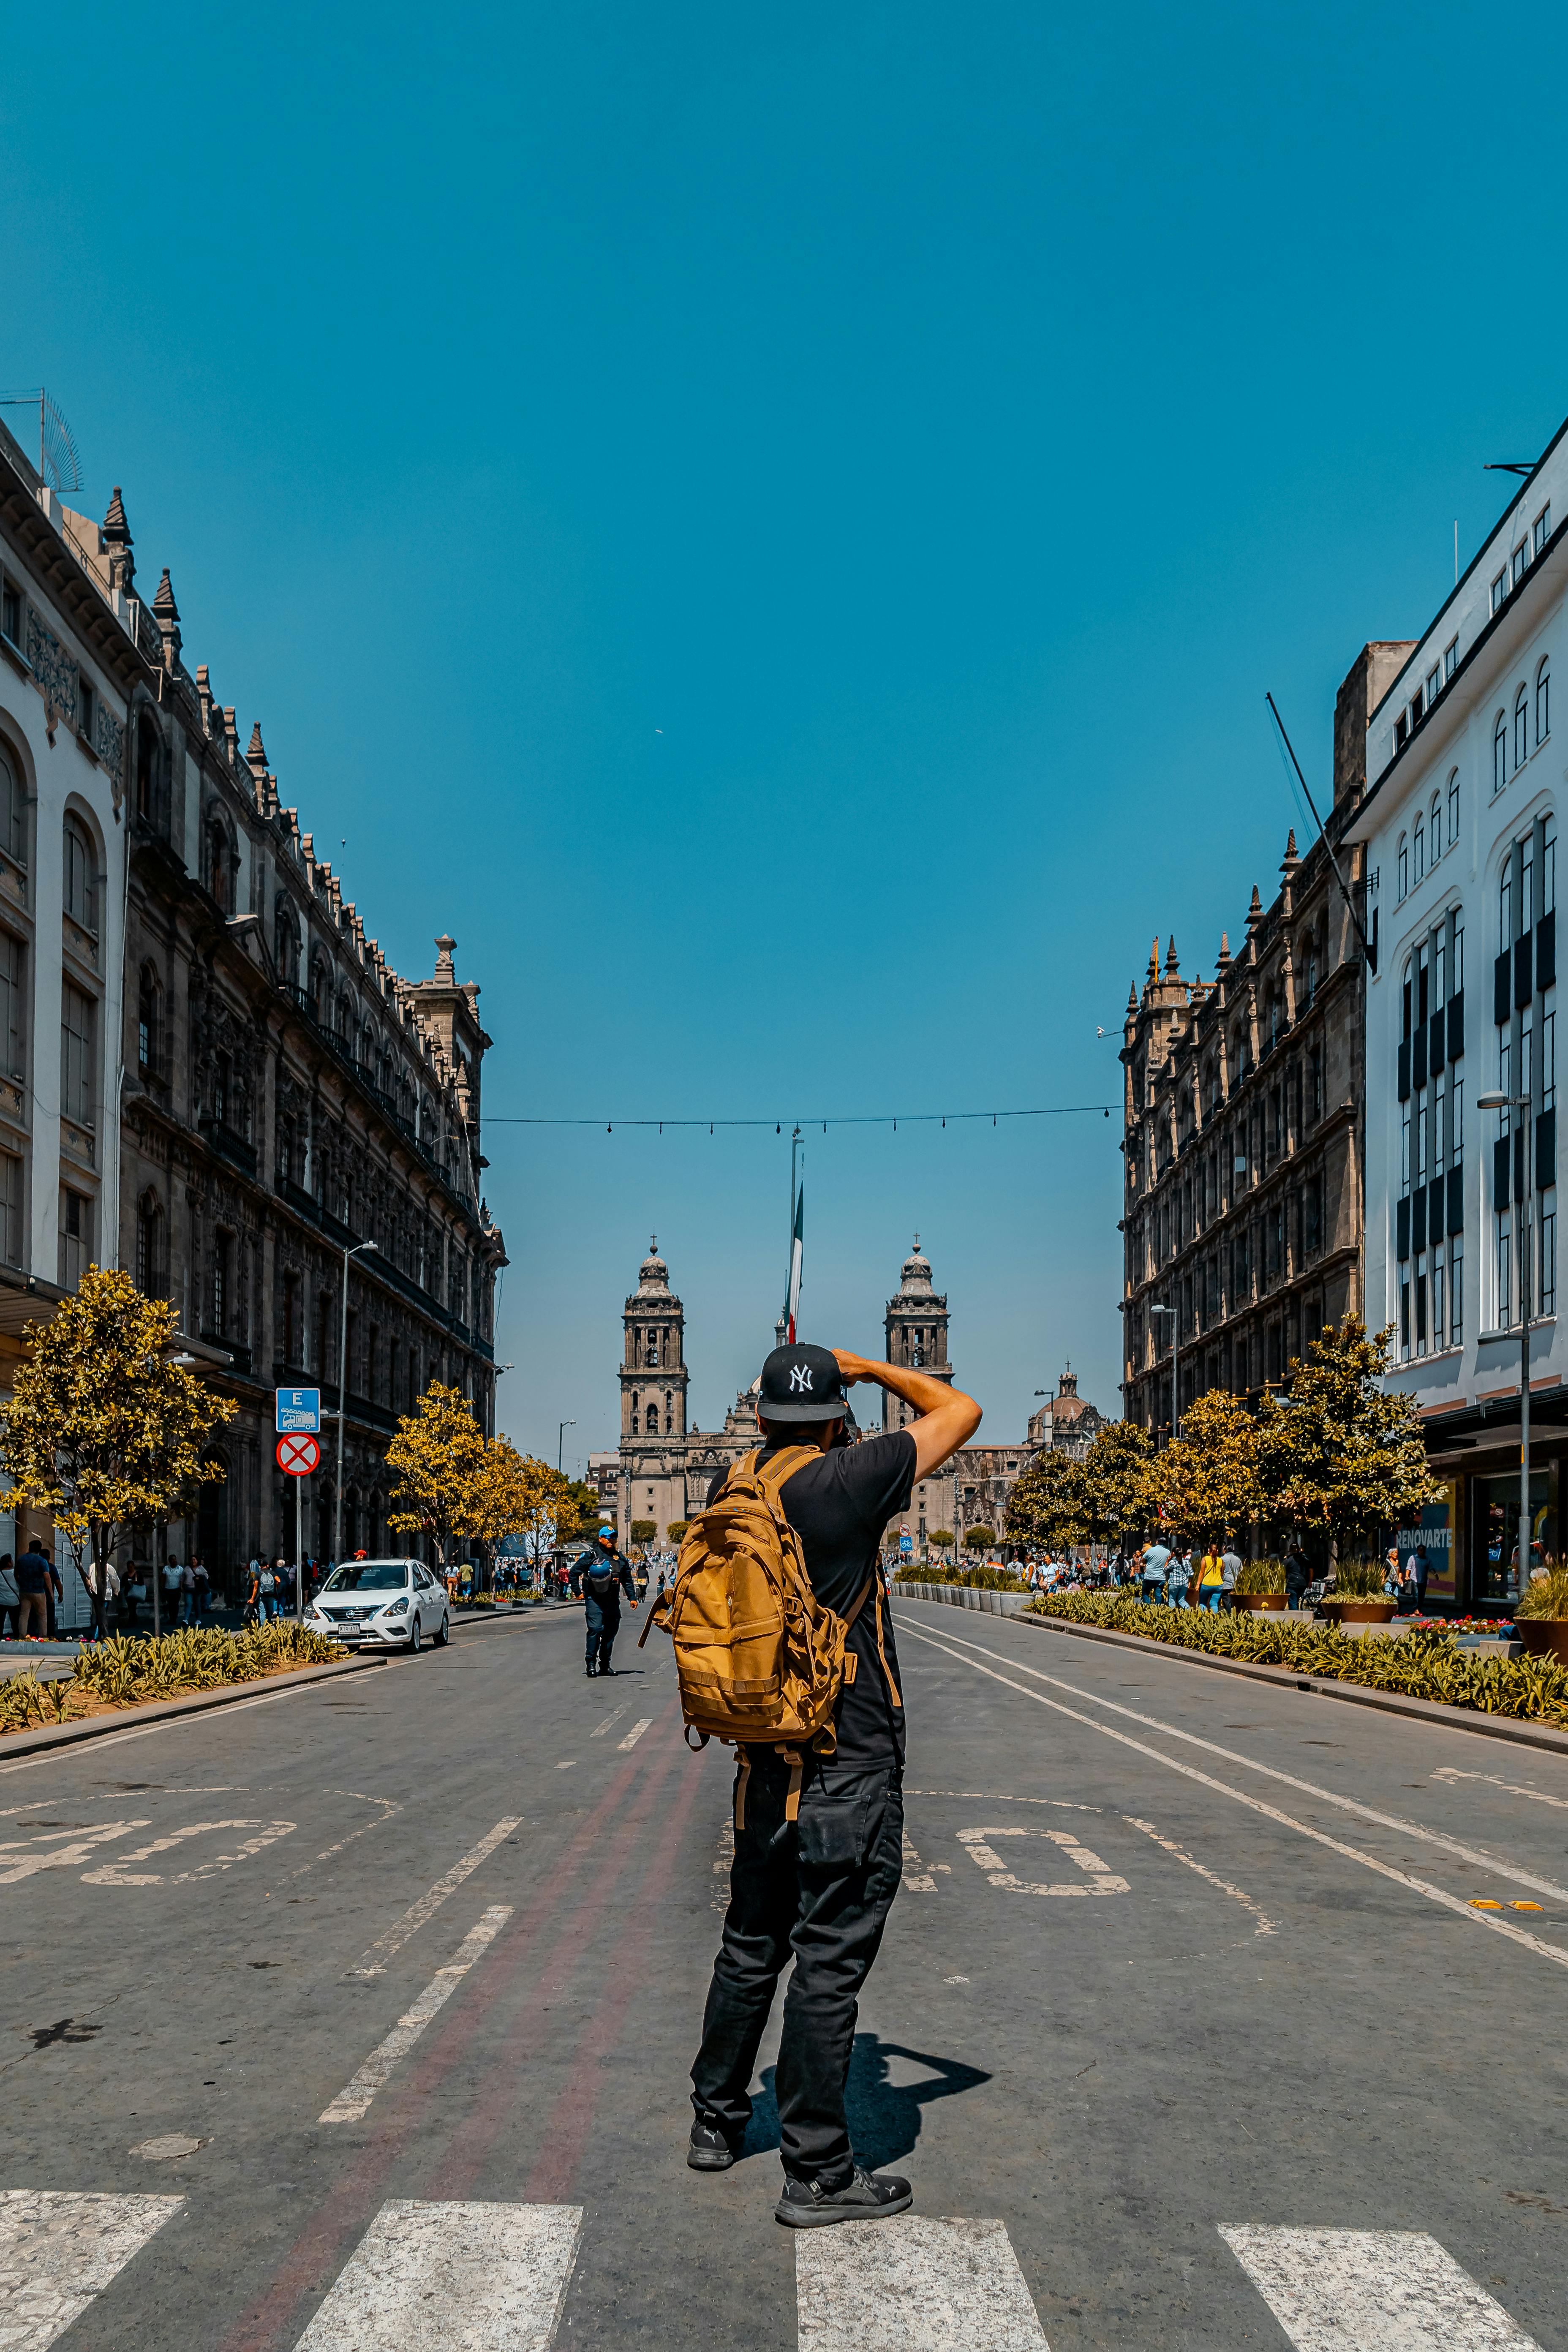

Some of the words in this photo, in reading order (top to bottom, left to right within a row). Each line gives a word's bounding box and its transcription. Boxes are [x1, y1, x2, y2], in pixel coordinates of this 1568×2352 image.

[789, 1364, 813, 1392] NY
[292, 1392, 302, 1405] E
[1396, 1528, 1453, 1549] RENOVARTE
